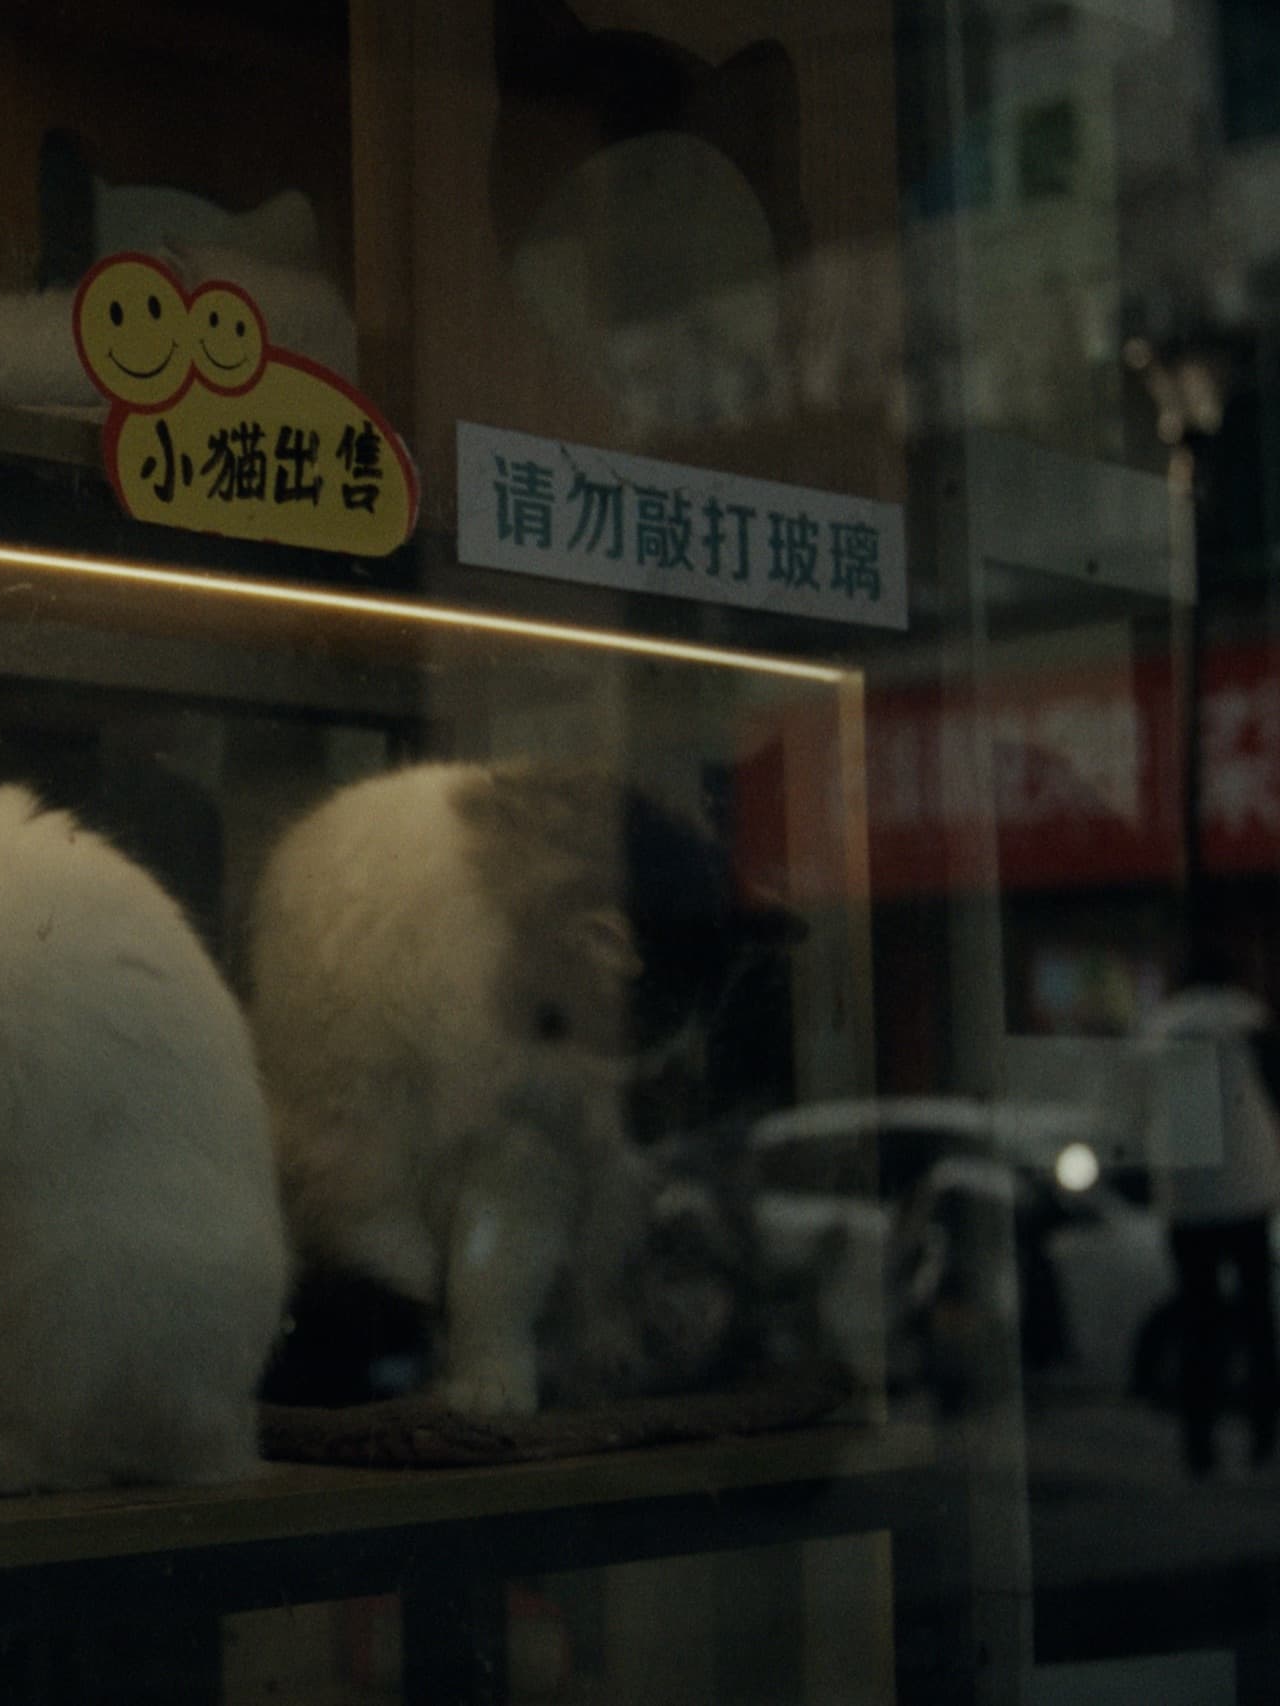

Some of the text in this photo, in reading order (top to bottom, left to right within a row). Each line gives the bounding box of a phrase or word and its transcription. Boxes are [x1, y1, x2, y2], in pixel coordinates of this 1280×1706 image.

[140, 418, 384, 514] 小猫出售
[493, 454, 882, 602] 请勿敲打玻璃
